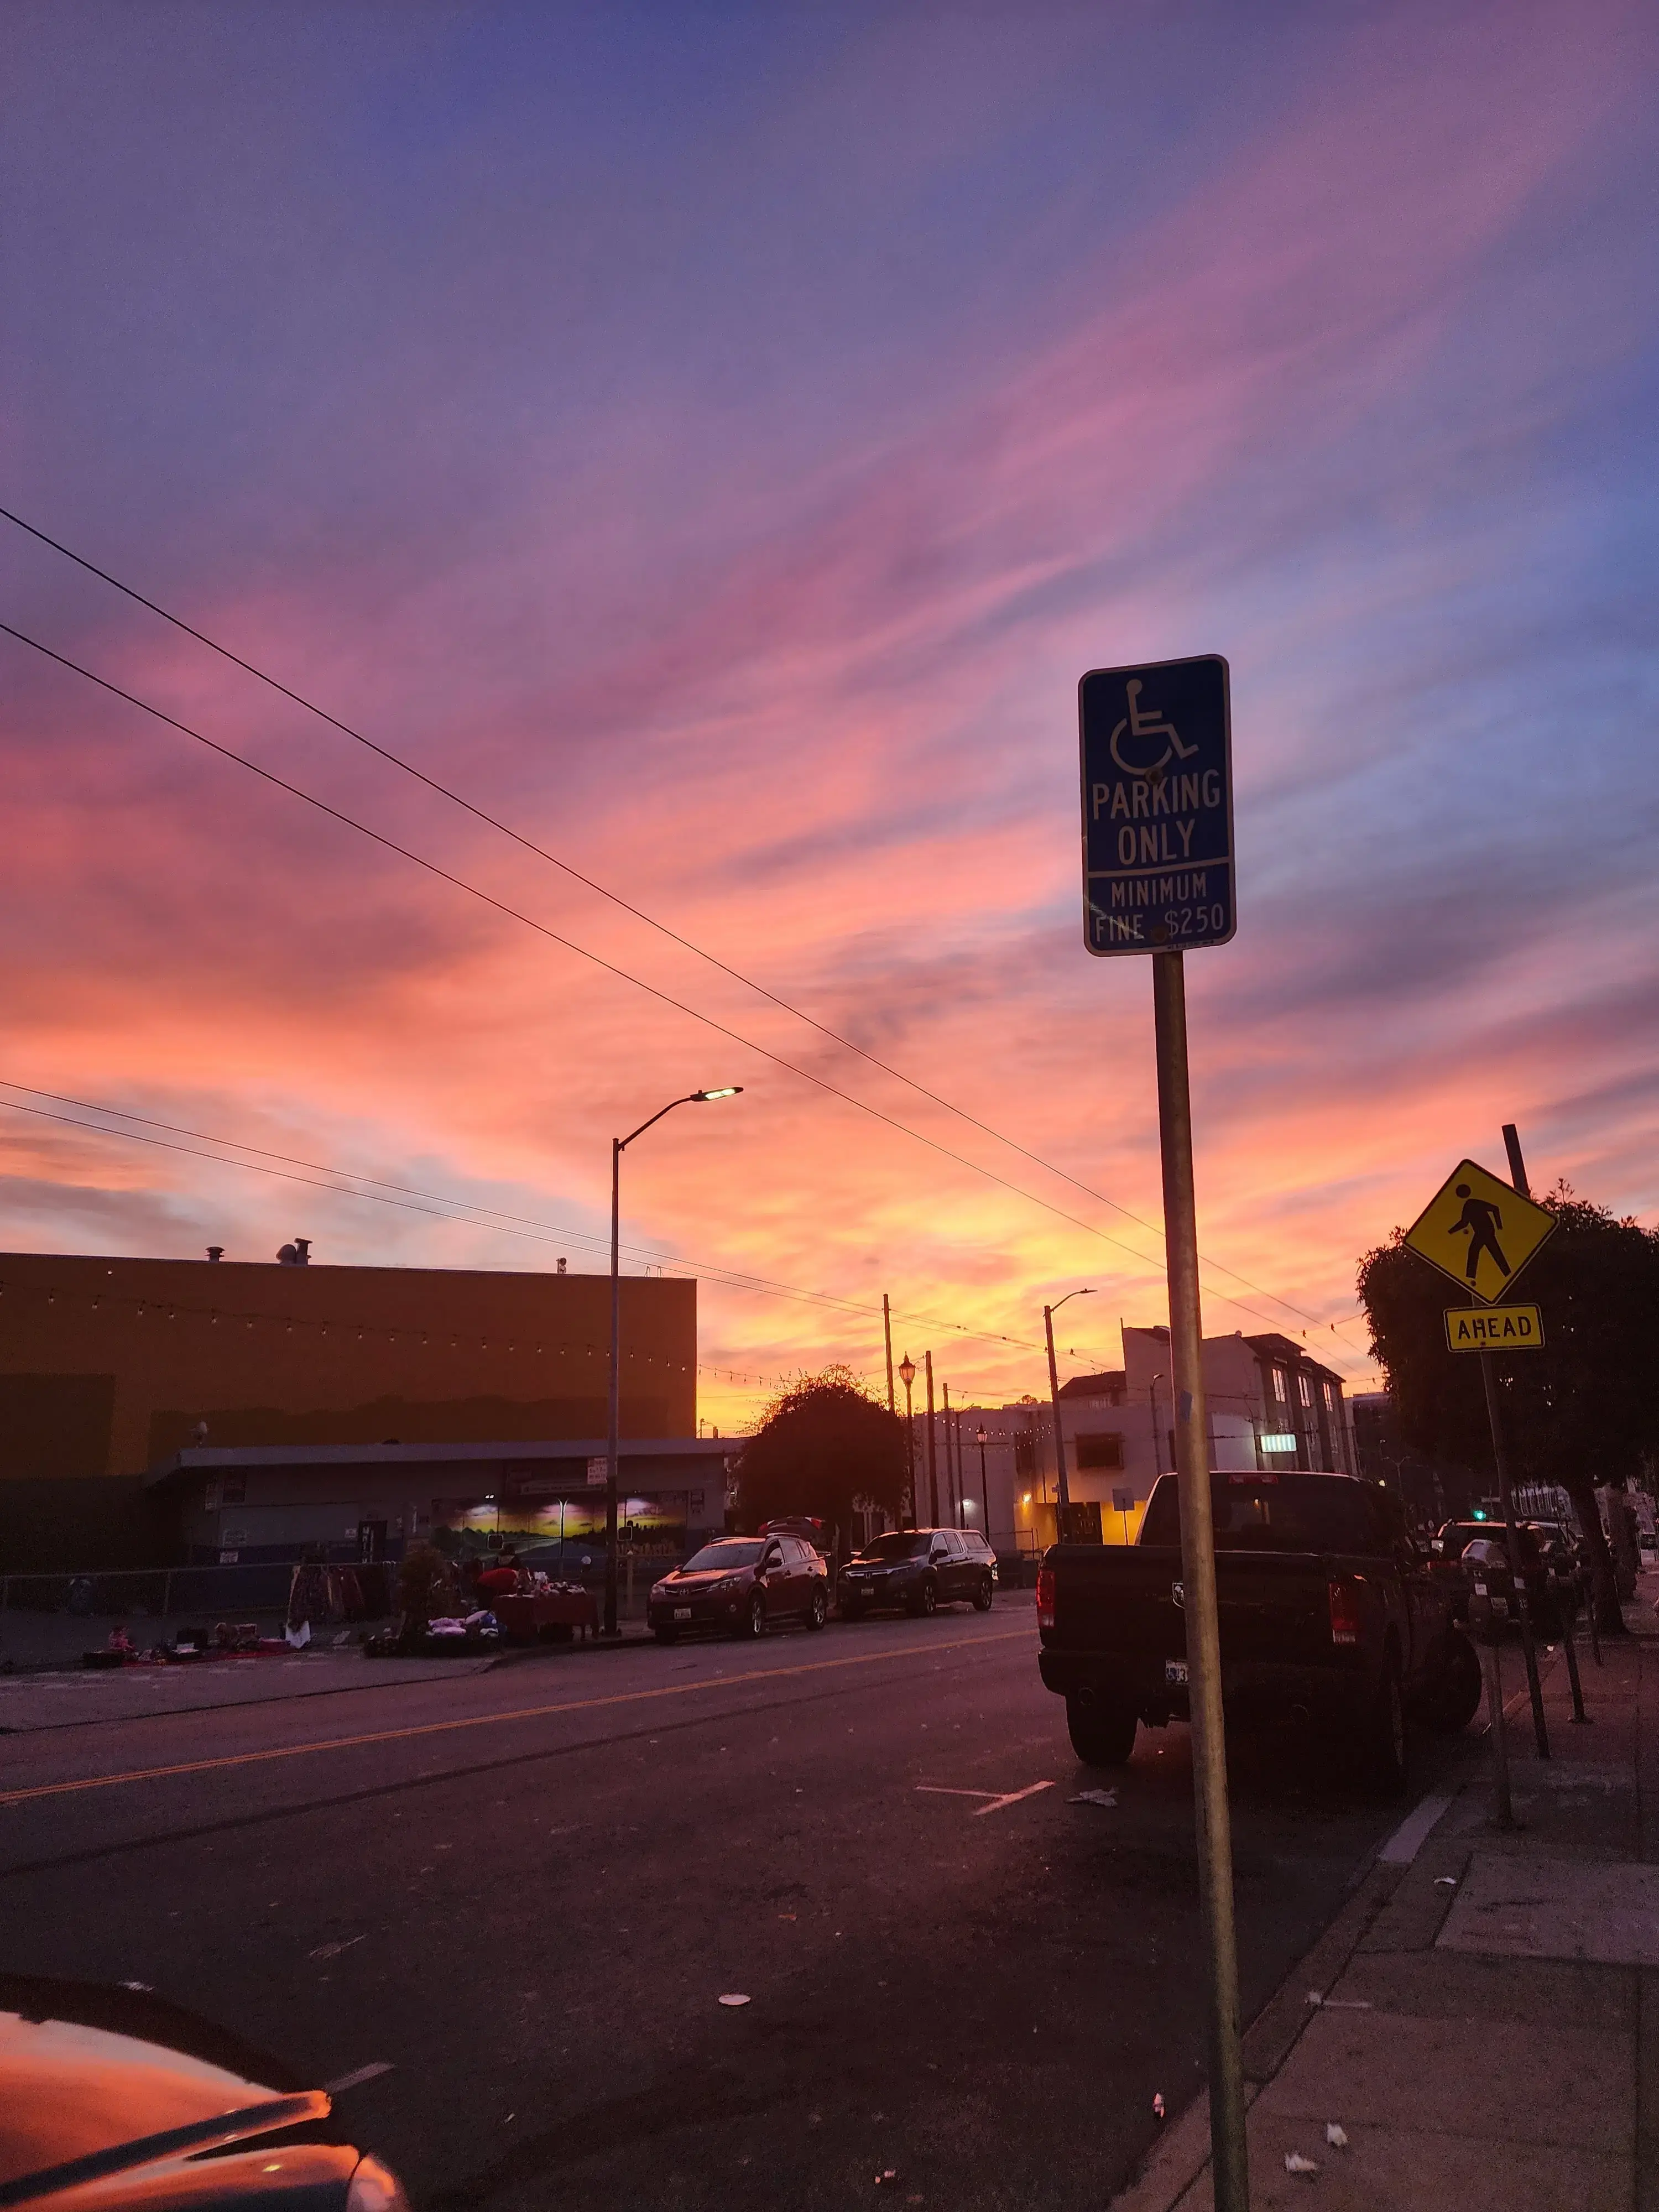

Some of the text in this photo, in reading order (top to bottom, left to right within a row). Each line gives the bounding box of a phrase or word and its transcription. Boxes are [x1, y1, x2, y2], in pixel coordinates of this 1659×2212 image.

[1093, 769, 1220, 820] PARKING
[1118, 818, 1196, 865] ONLY
[1111, 872, 1207, 907] MINIMUM
[1095, 903, 1224, 942] FINE $250
[1458, 1316, 1531, 1339] AHEAD
